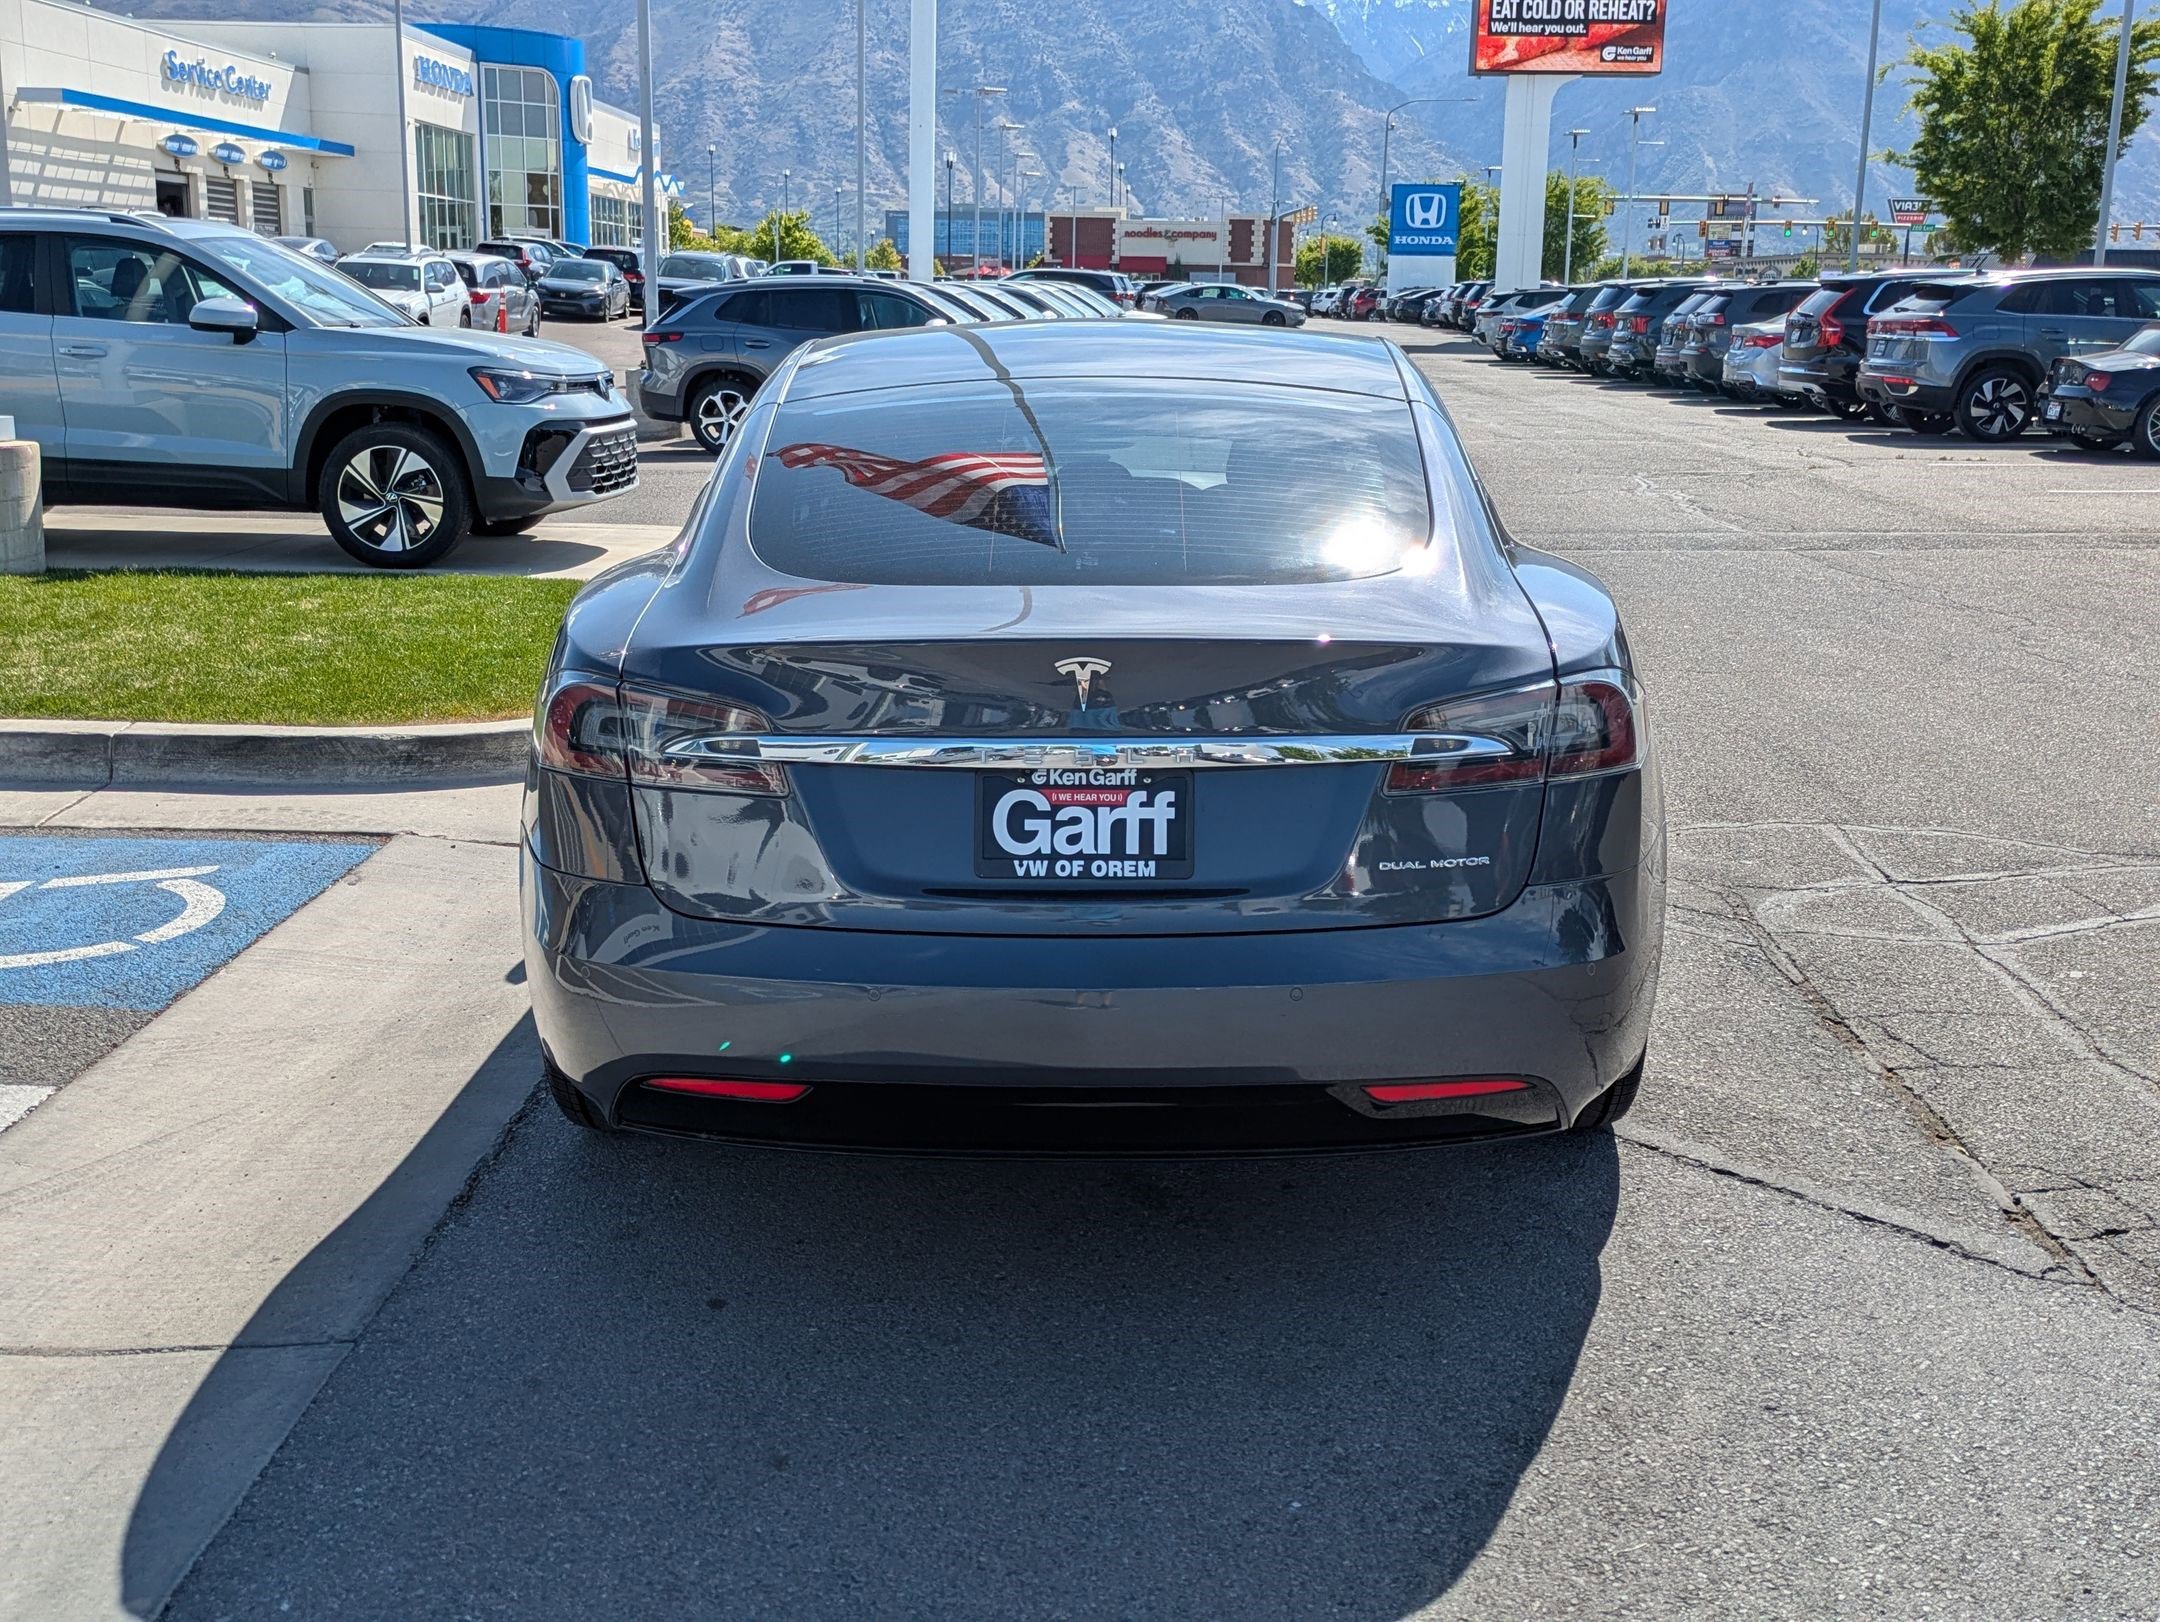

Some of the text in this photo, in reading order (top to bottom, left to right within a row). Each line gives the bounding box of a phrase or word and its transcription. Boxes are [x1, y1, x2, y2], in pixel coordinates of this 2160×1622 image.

[1492, 0, 1656, 21] EAT COLD OR REHEAT?
[1491, 22, 1587, 36] We'll hear you out.
[1617, 46, 1653, 55] Ken Garff
[167, 50, 272, 102] Service Center
[418, 55, 474, 97] HONDA
[1124, 227, 1163, 239] noodles
[1171, 230, 1217, 242] company
[1394, 235, 1455, 245] HONDA
[975, 747, 1194, 766] TESLA
[1049, 768, 1138, 786] Ken Garff
[1058, 793, 1072, 801] WE
[1099, 794, 1117, 802] YOU
[992, 789, 1176, 856] Garff
[1013, 860, 1156, 877] VW OF OREM
[1379, 856, 1490, 870] DUAL MOTOR
